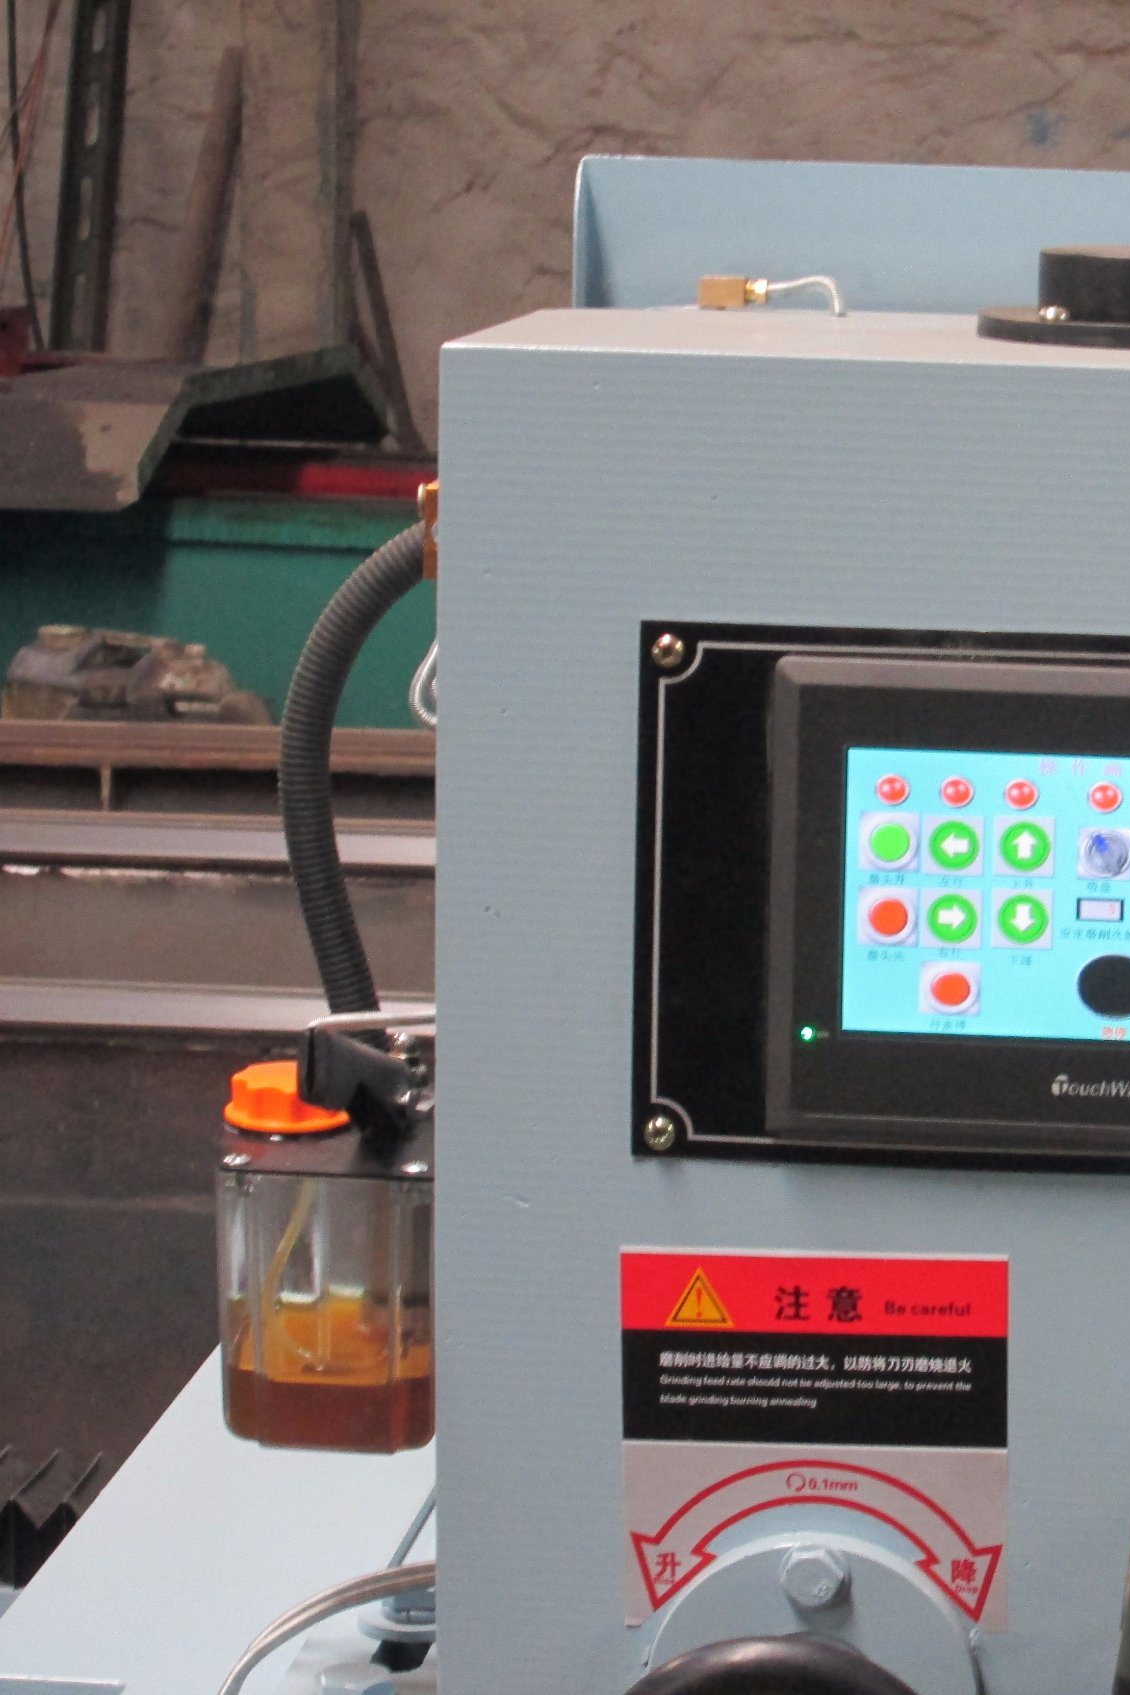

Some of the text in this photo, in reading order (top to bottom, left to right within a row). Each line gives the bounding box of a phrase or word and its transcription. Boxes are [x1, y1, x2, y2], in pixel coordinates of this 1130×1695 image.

[774, 1285, 863, 1323] 注意
[884, 1301, 971, 1317] Be careful
[747, 1376, 780, 1387] should
[954, 1380, 972, 1391] the
[808, 1478, 858, 1491] 0.1mm
[655, 1552, 681, 1580] 升
[951, 1558, 977, 1584] 降
